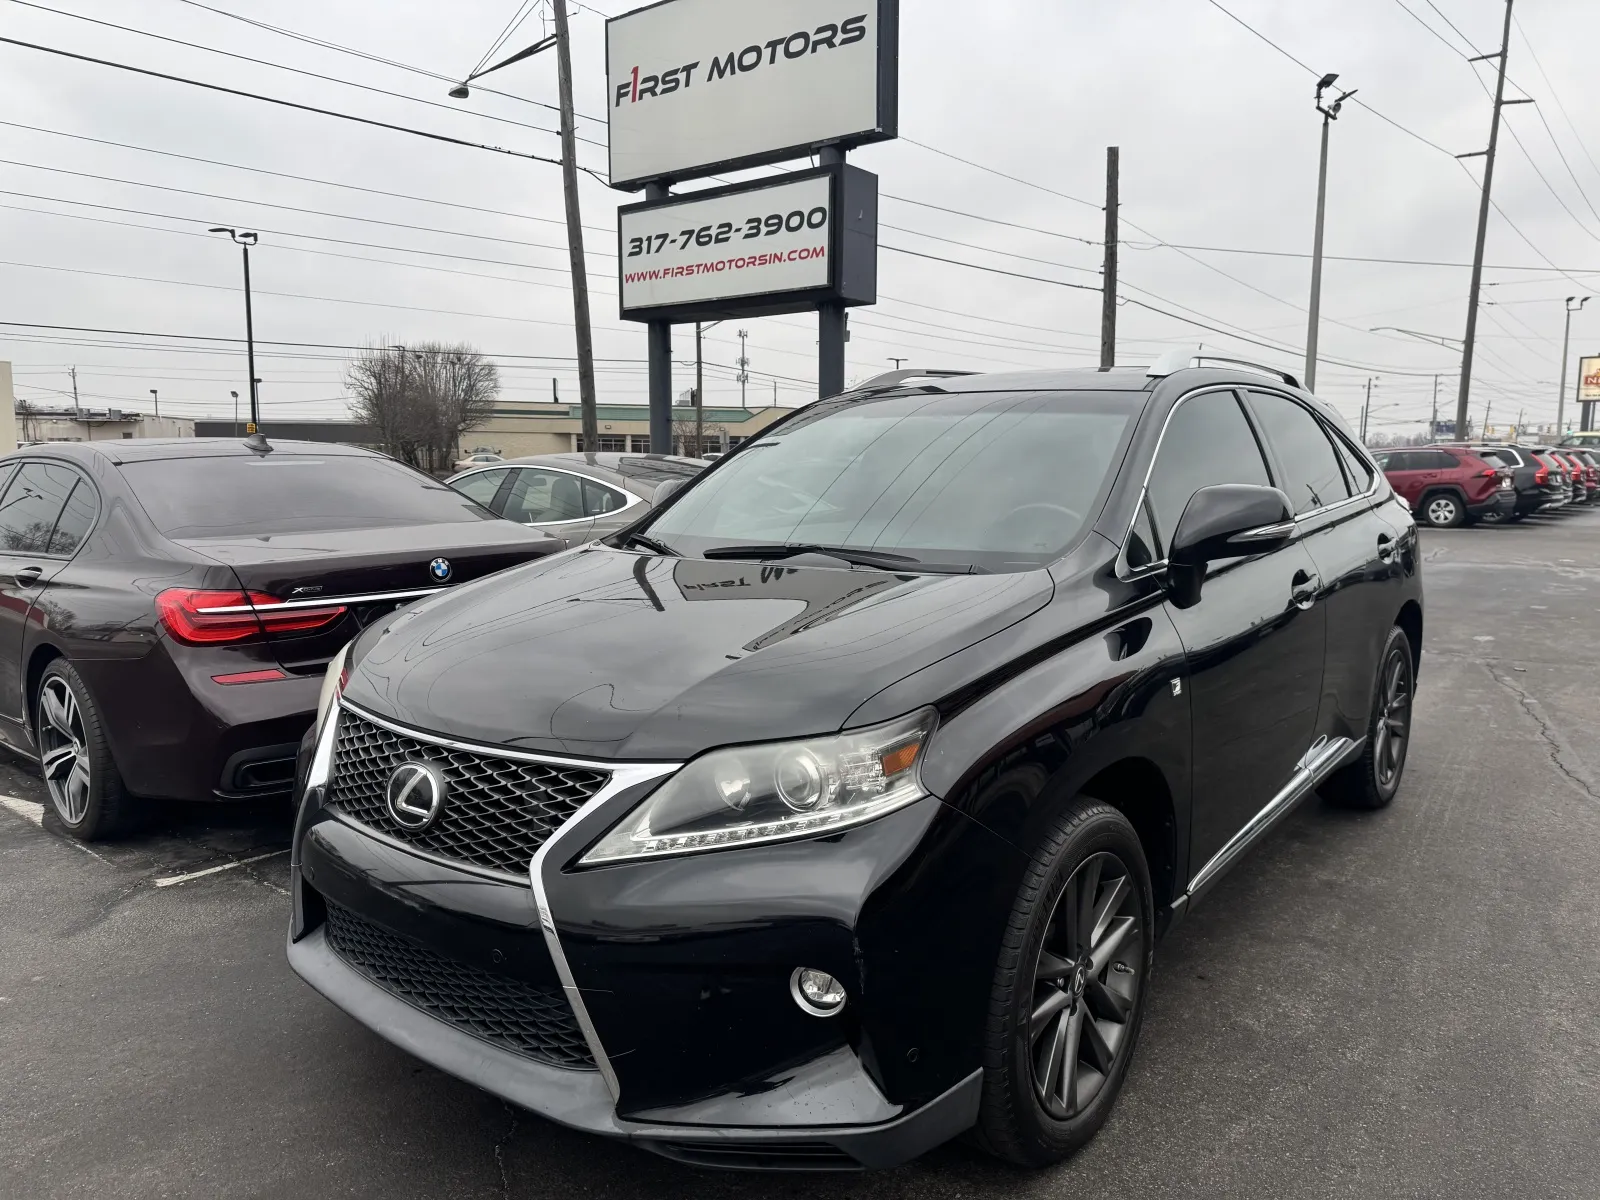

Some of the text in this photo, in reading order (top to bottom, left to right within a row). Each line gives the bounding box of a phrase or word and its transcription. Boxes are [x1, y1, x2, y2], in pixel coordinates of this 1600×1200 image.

[706, 14, 868, 83] MOTORS
[627, 206, 827, 258] 317-762-3900
[625, 245, 825, 284] WWW.FIRSTMOTORSIN.COM
